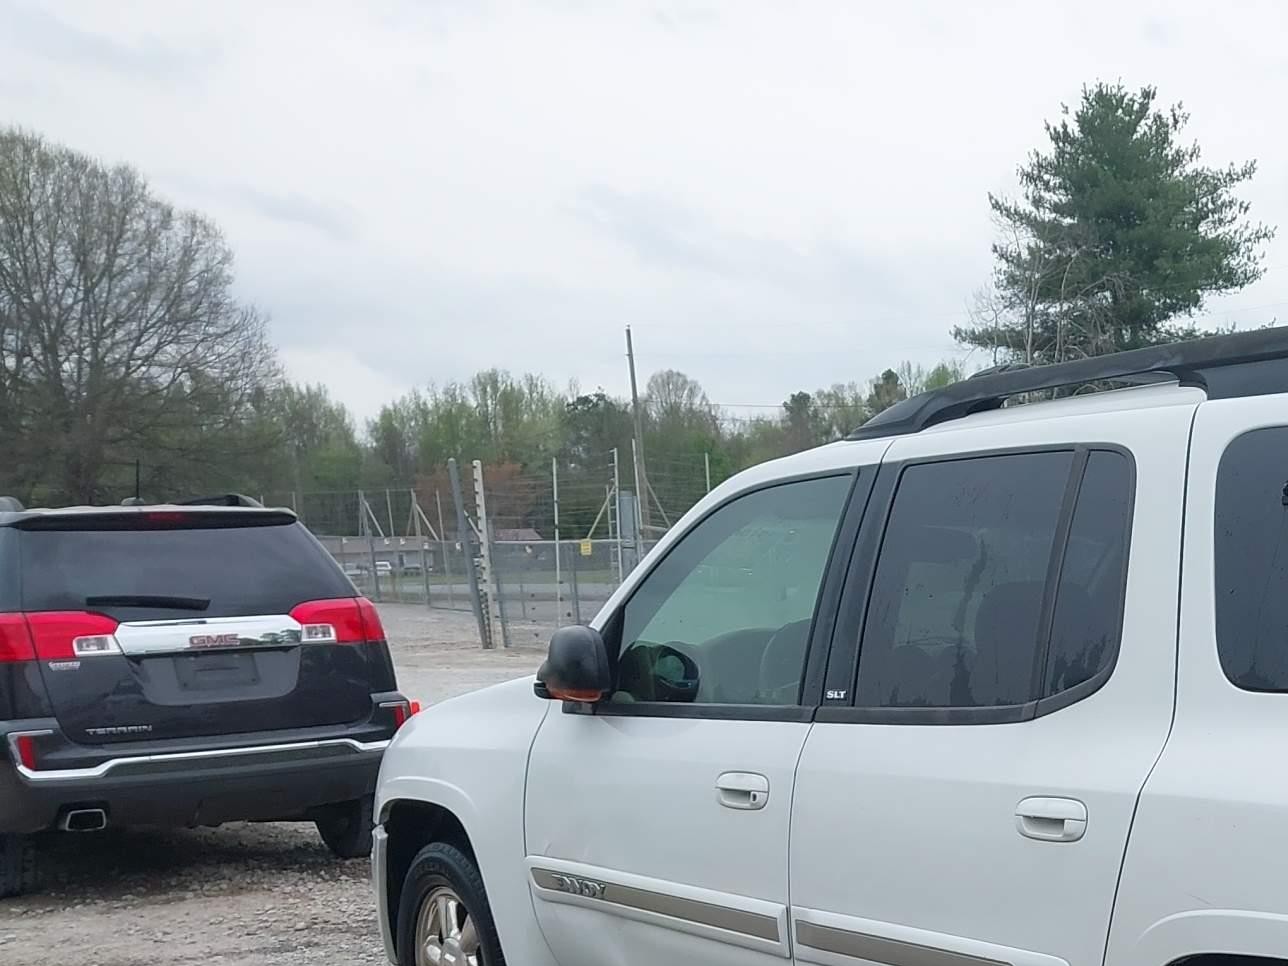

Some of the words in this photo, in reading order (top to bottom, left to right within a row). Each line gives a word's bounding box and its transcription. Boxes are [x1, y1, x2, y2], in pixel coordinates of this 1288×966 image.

[189, 633, 240, 648] GMC
[826, 690, 847, 699] SLT
[85, 725, 153, 736] TERRAIN
